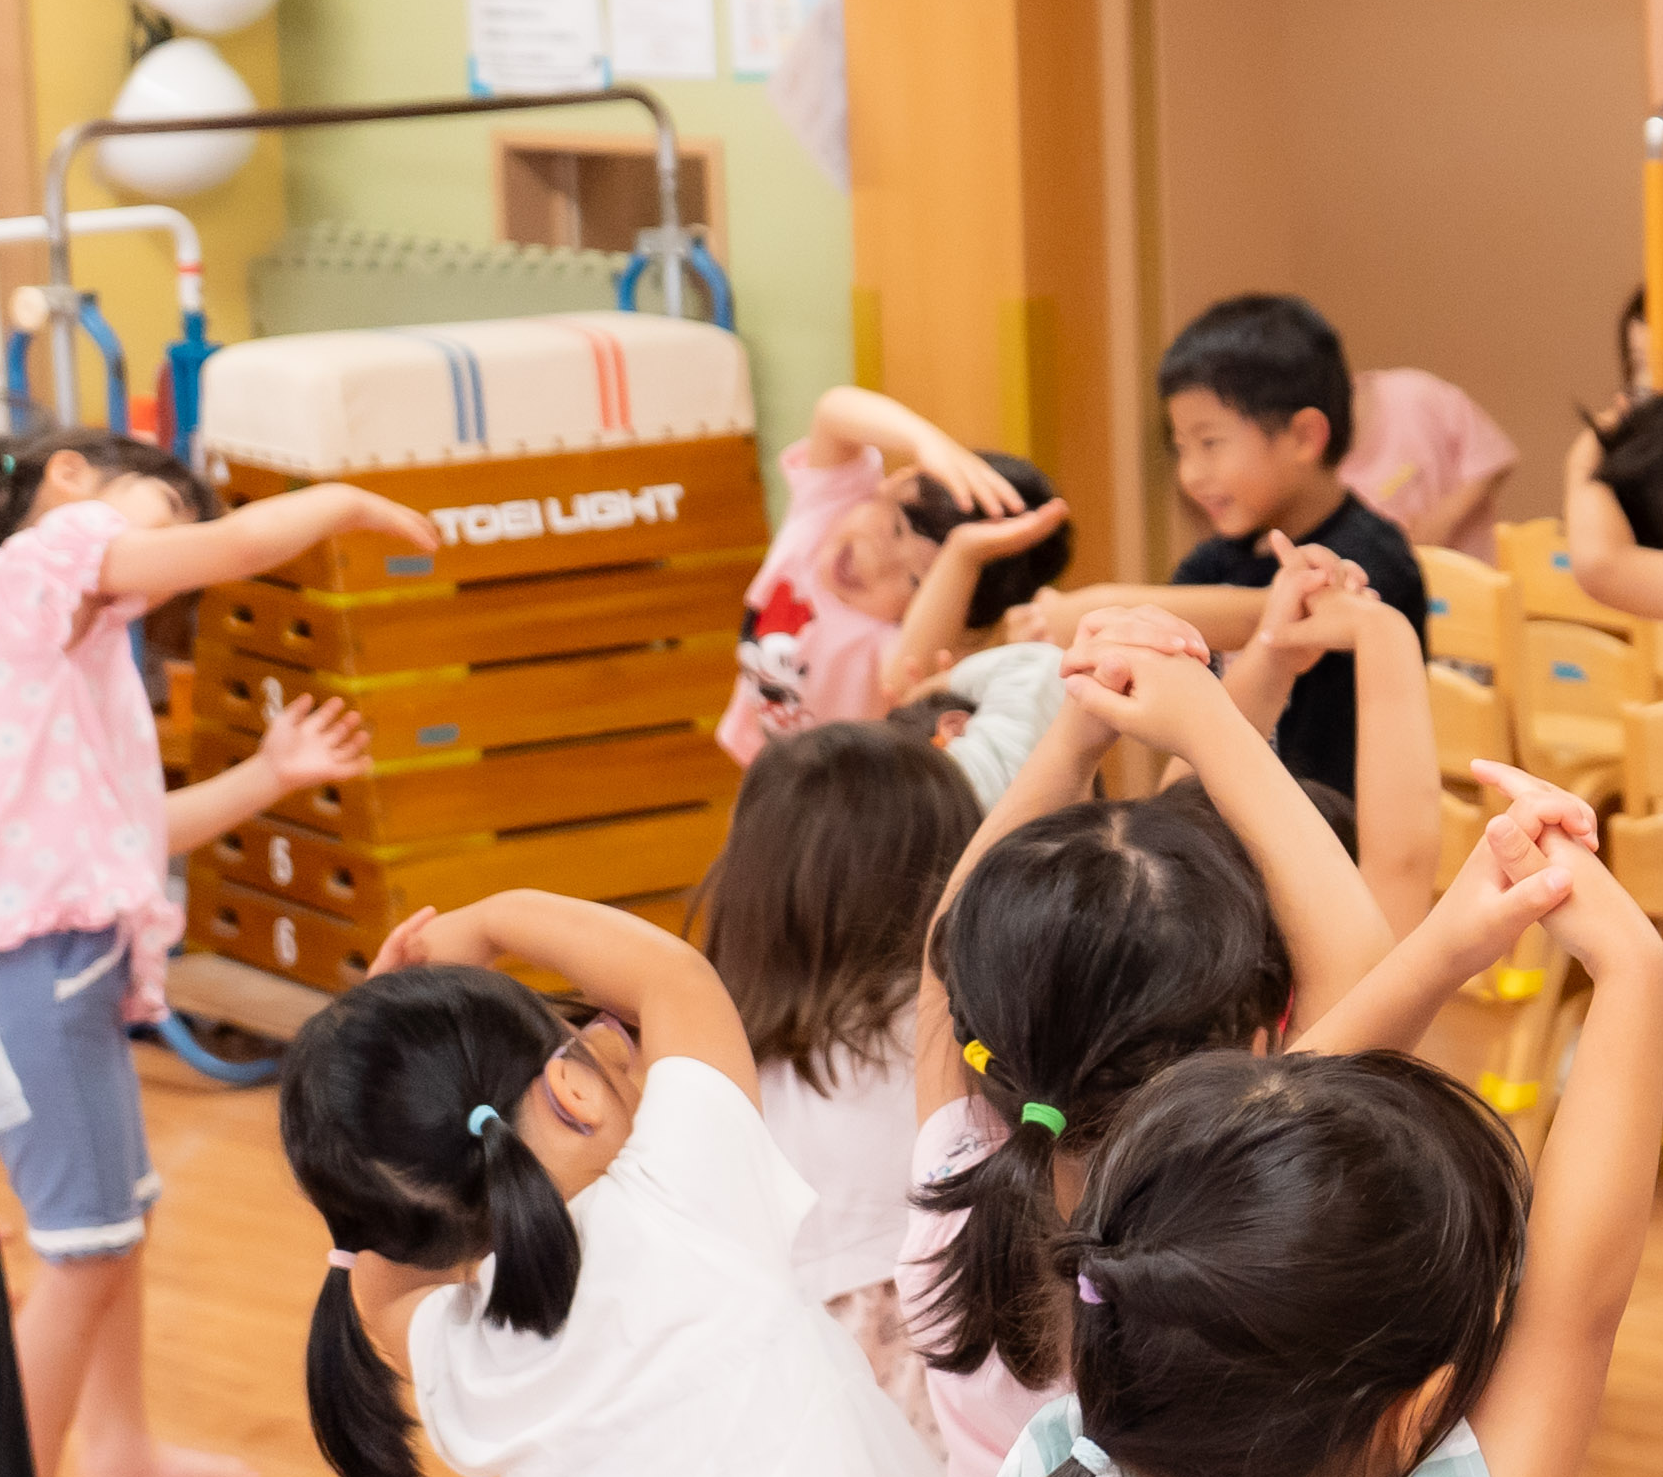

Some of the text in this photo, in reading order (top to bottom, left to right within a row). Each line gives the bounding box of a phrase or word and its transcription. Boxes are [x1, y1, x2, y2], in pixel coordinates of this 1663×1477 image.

[429, 482, 685, 546] TOEI LIGHT
[272, 916, 299, 968] 6
